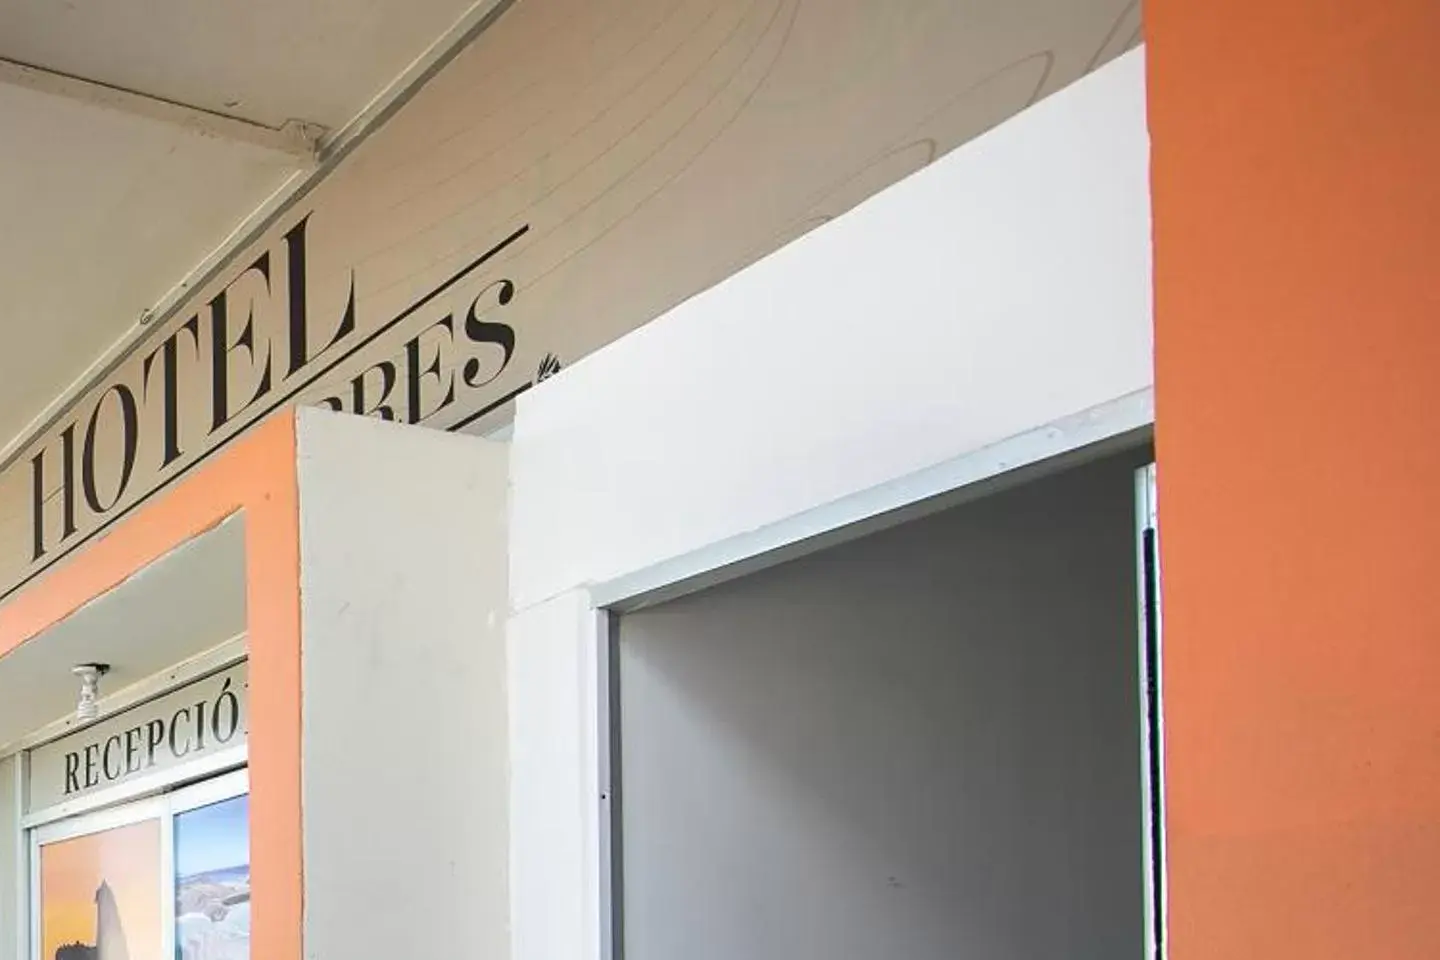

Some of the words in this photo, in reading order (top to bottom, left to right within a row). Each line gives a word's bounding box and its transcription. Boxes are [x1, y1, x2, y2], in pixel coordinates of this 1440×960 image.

[29, 210, 356, 562] HOTEL
[316, 279, 516, 425] RES
[64, 677, 247, 795] RECEPCIÓ
